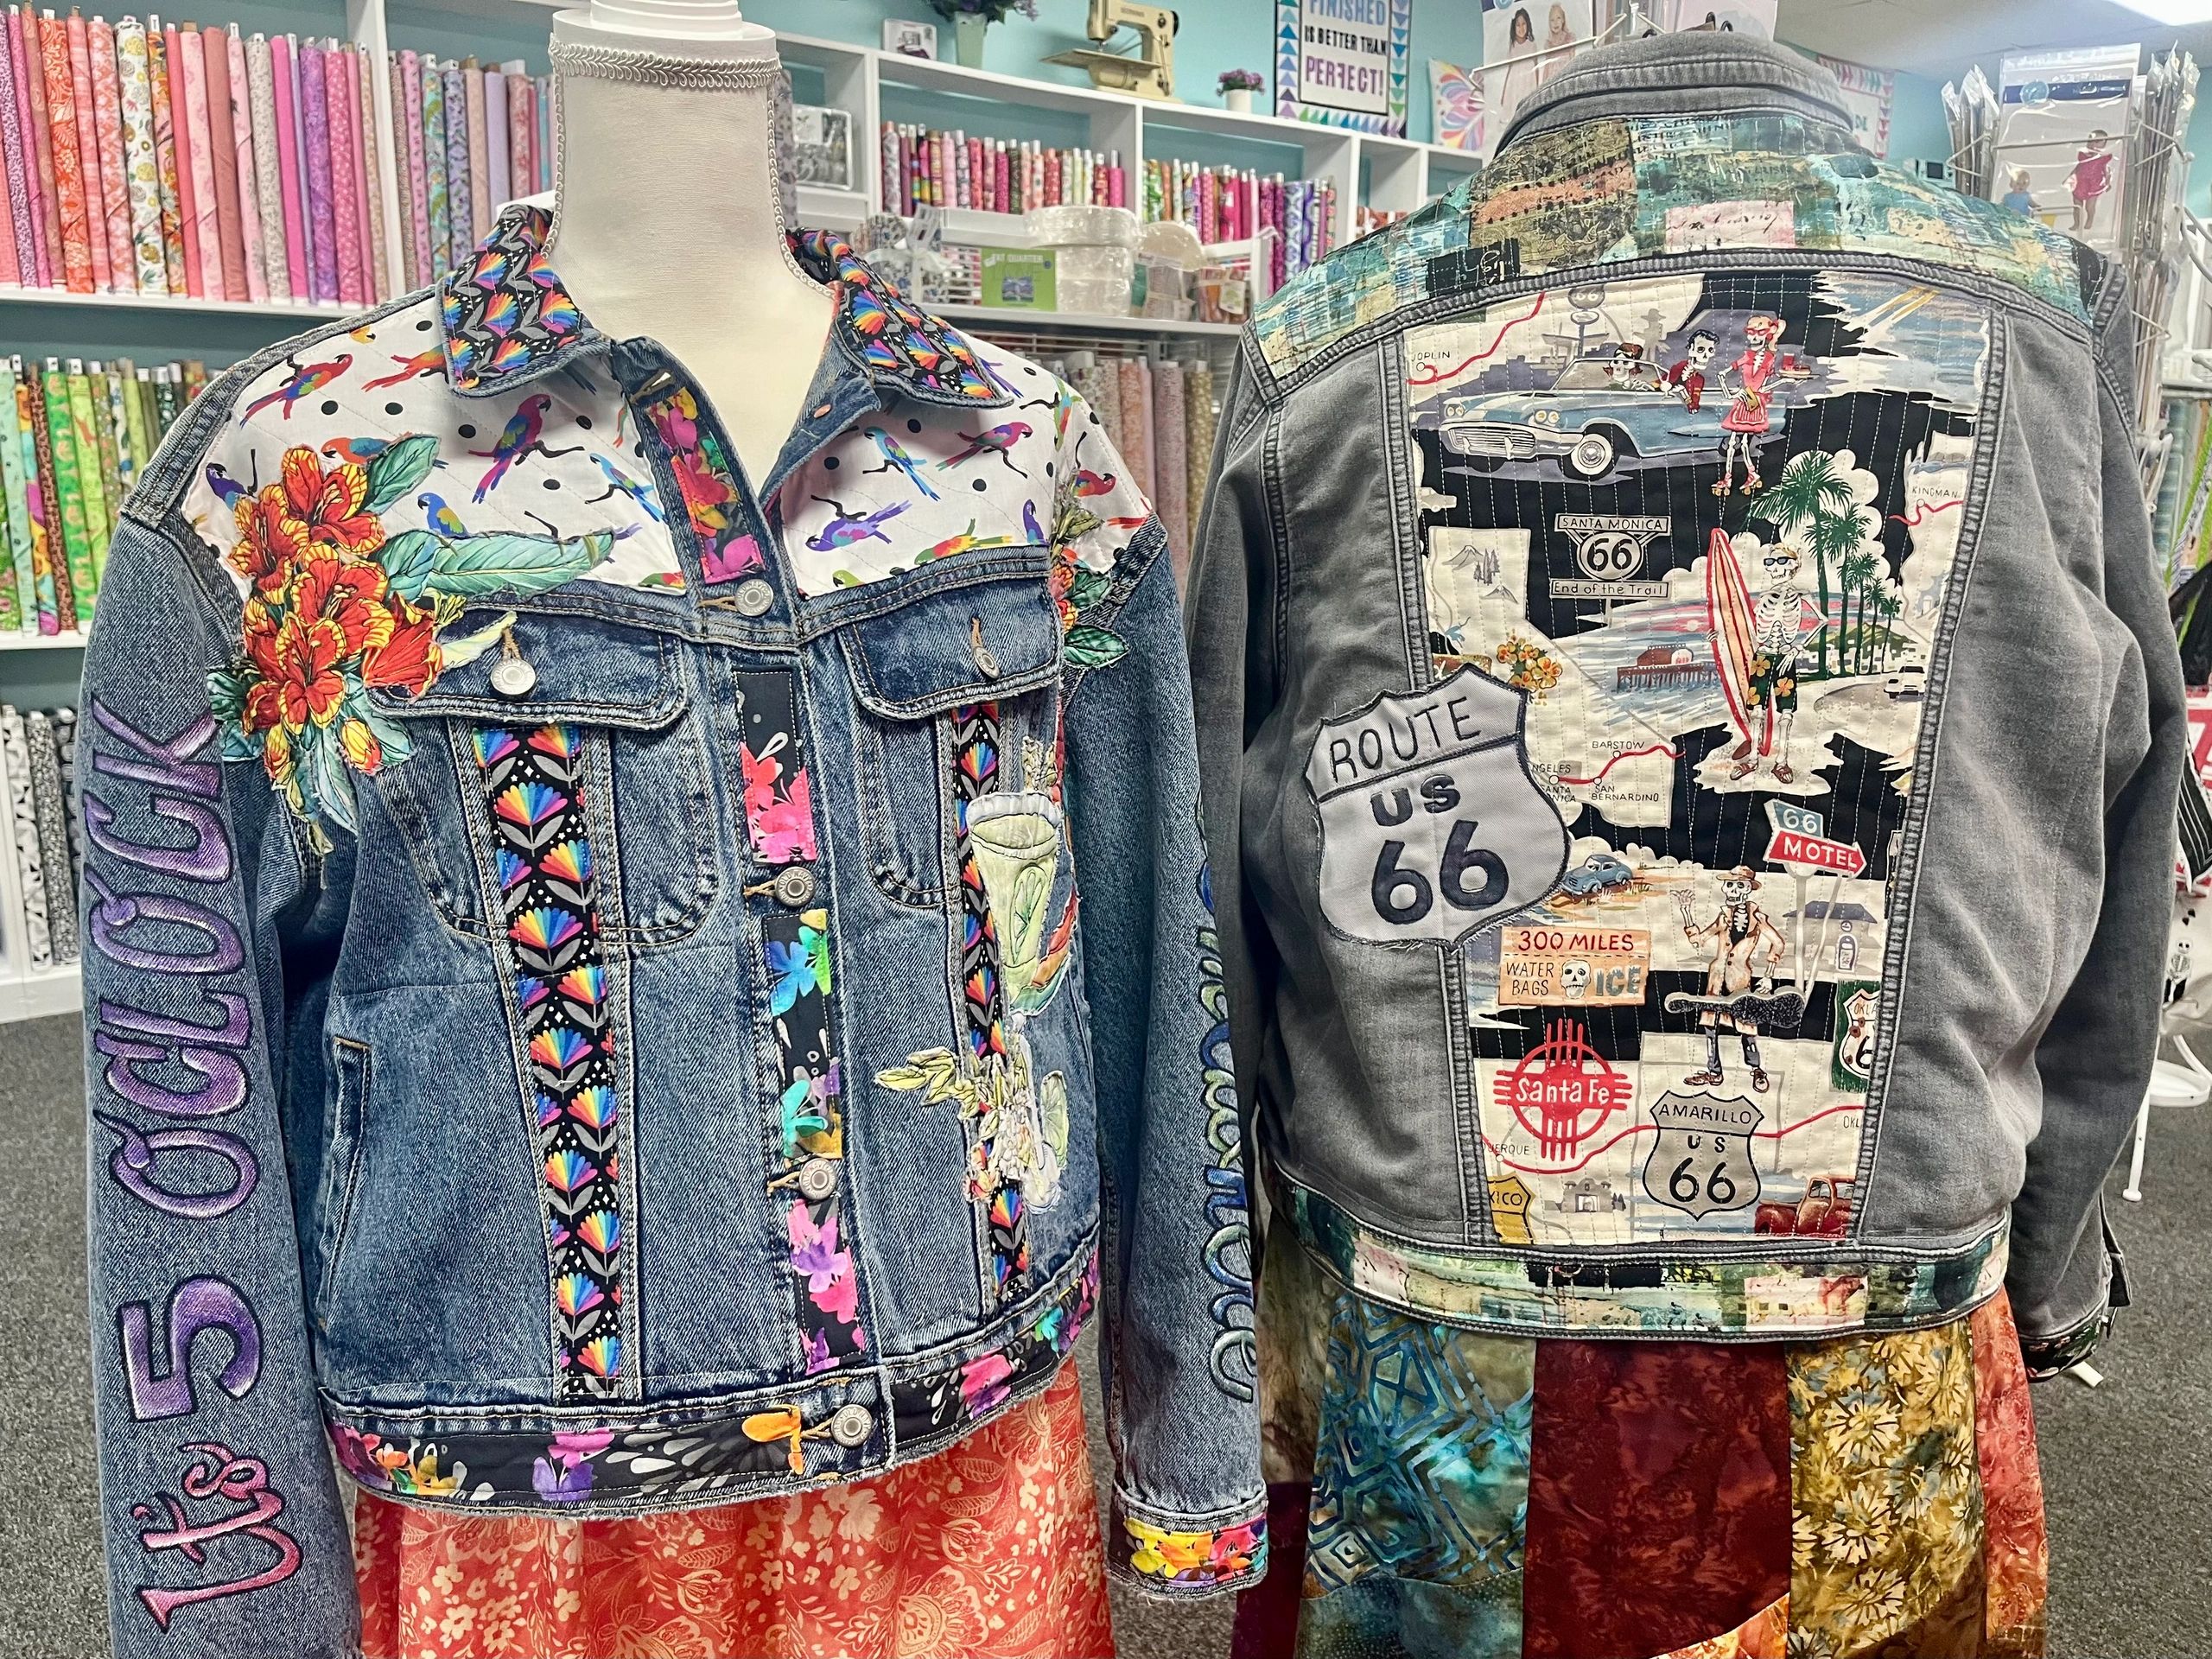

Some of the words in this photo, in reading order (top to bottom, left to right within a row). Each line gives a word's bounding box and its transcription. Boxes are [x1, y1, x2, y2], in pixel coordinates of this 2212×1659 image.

[1310, 0, 1386, 26] FINISHED
[1305, 25, 1315, 43] IS
[1319, 28, 1357, 52] BETTER
[1361, 36, 1388, 55] THAN
[1306, 55, 1384, 96] PERFECT!
[1411, 351, 1450, 362] JOPLIN
[1912, 486, 1958, 499] KINGMAN
[1562, 518, 1602, 529] SANTA
[1608, 519, 1662, 531] MONICA
[1587, 538, 1632, 572] 66
[1554, 582, 1579, 595] End
[1584, 582, 1599, 594] of
[1602, 582, 1624, 594] the
[1630, 584, 1662, 595] Trail
[1330, 696, 1482, 783] ROUTE
[1592, 741, 1644, 750] BARSTOW
[1370, 774, 1461, 827] US
[1591, 792, 1659, 802] BERNARDINO
[1783, 808, 1818, 834] 66
[1783, 836, 1858, 868] MOTEL
[1371, 819, 1510, 925] 66
[1518, 931, 1563, 951] 300
[1569, 934, 1634, 951] MILES
[1506, 962, 1554, 978] WATER
[1593, 964, 1642, 997] ICE
[1512, 979, 1549, 996] BAGS
[1516, 1077, 1582, 1103] Santa
[1588, 1078, 1610, 1105] Fe
[1658, 1103, 1751, 1124] AMARILLO
[1843, 1115, 1859, 1128] OKL
[1669, 1157, 1736, 1205] 66
[118, 1273, 264, 1423] 5
